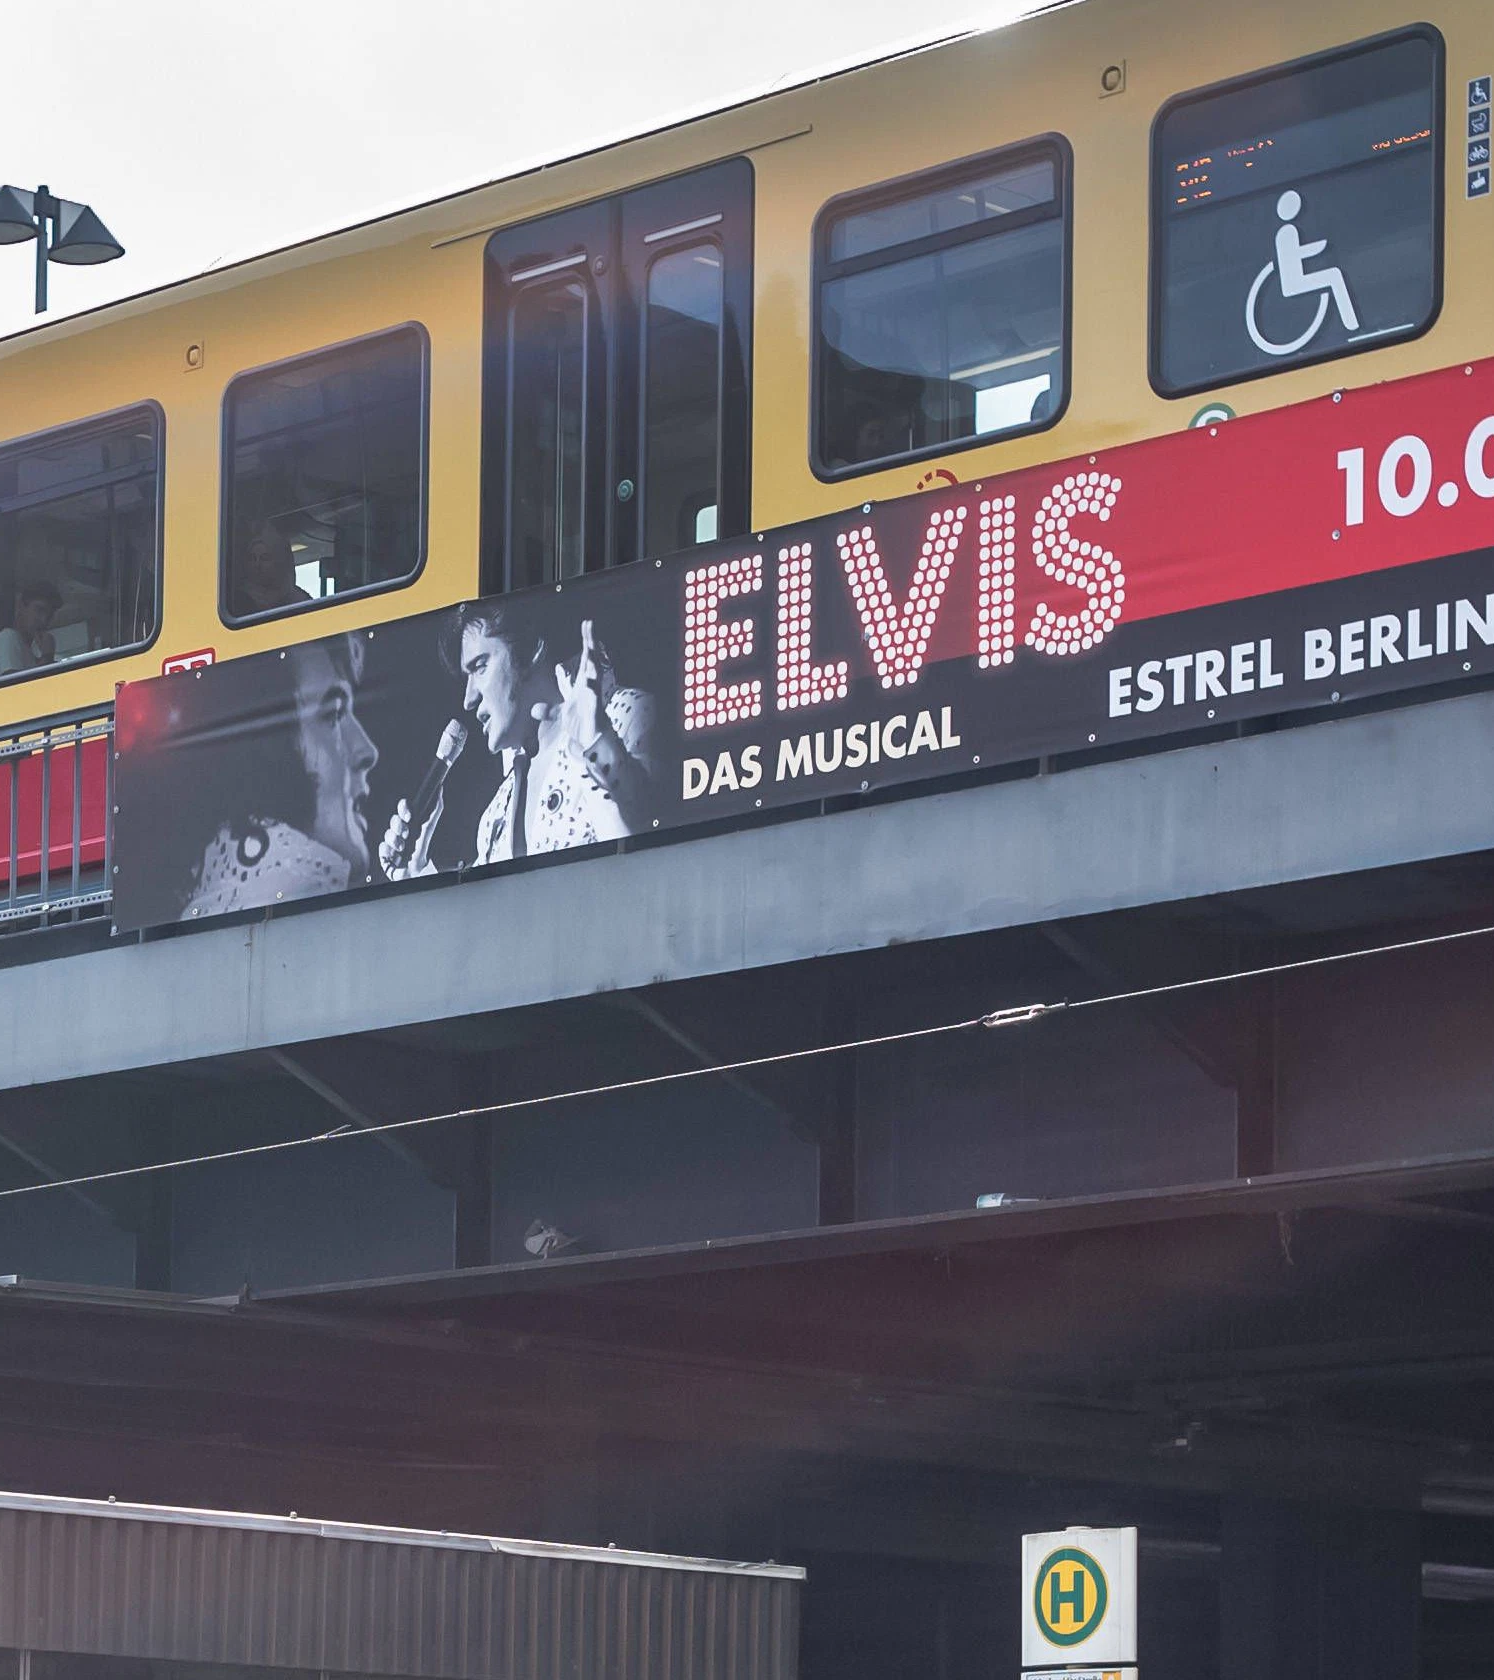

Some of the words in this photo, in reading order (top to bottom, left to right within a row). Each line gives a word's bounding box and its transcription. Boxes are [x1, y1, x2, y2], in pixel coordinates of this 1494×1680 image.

[683, 471, 1126, 732] ELVIS
[1108, 638, 1284, 718] ESTREL
[681, 744, 763, 800] DAS
[774, 704, 962, 782] MUSICAL
[1050, 1570, 1085, 1625] H
